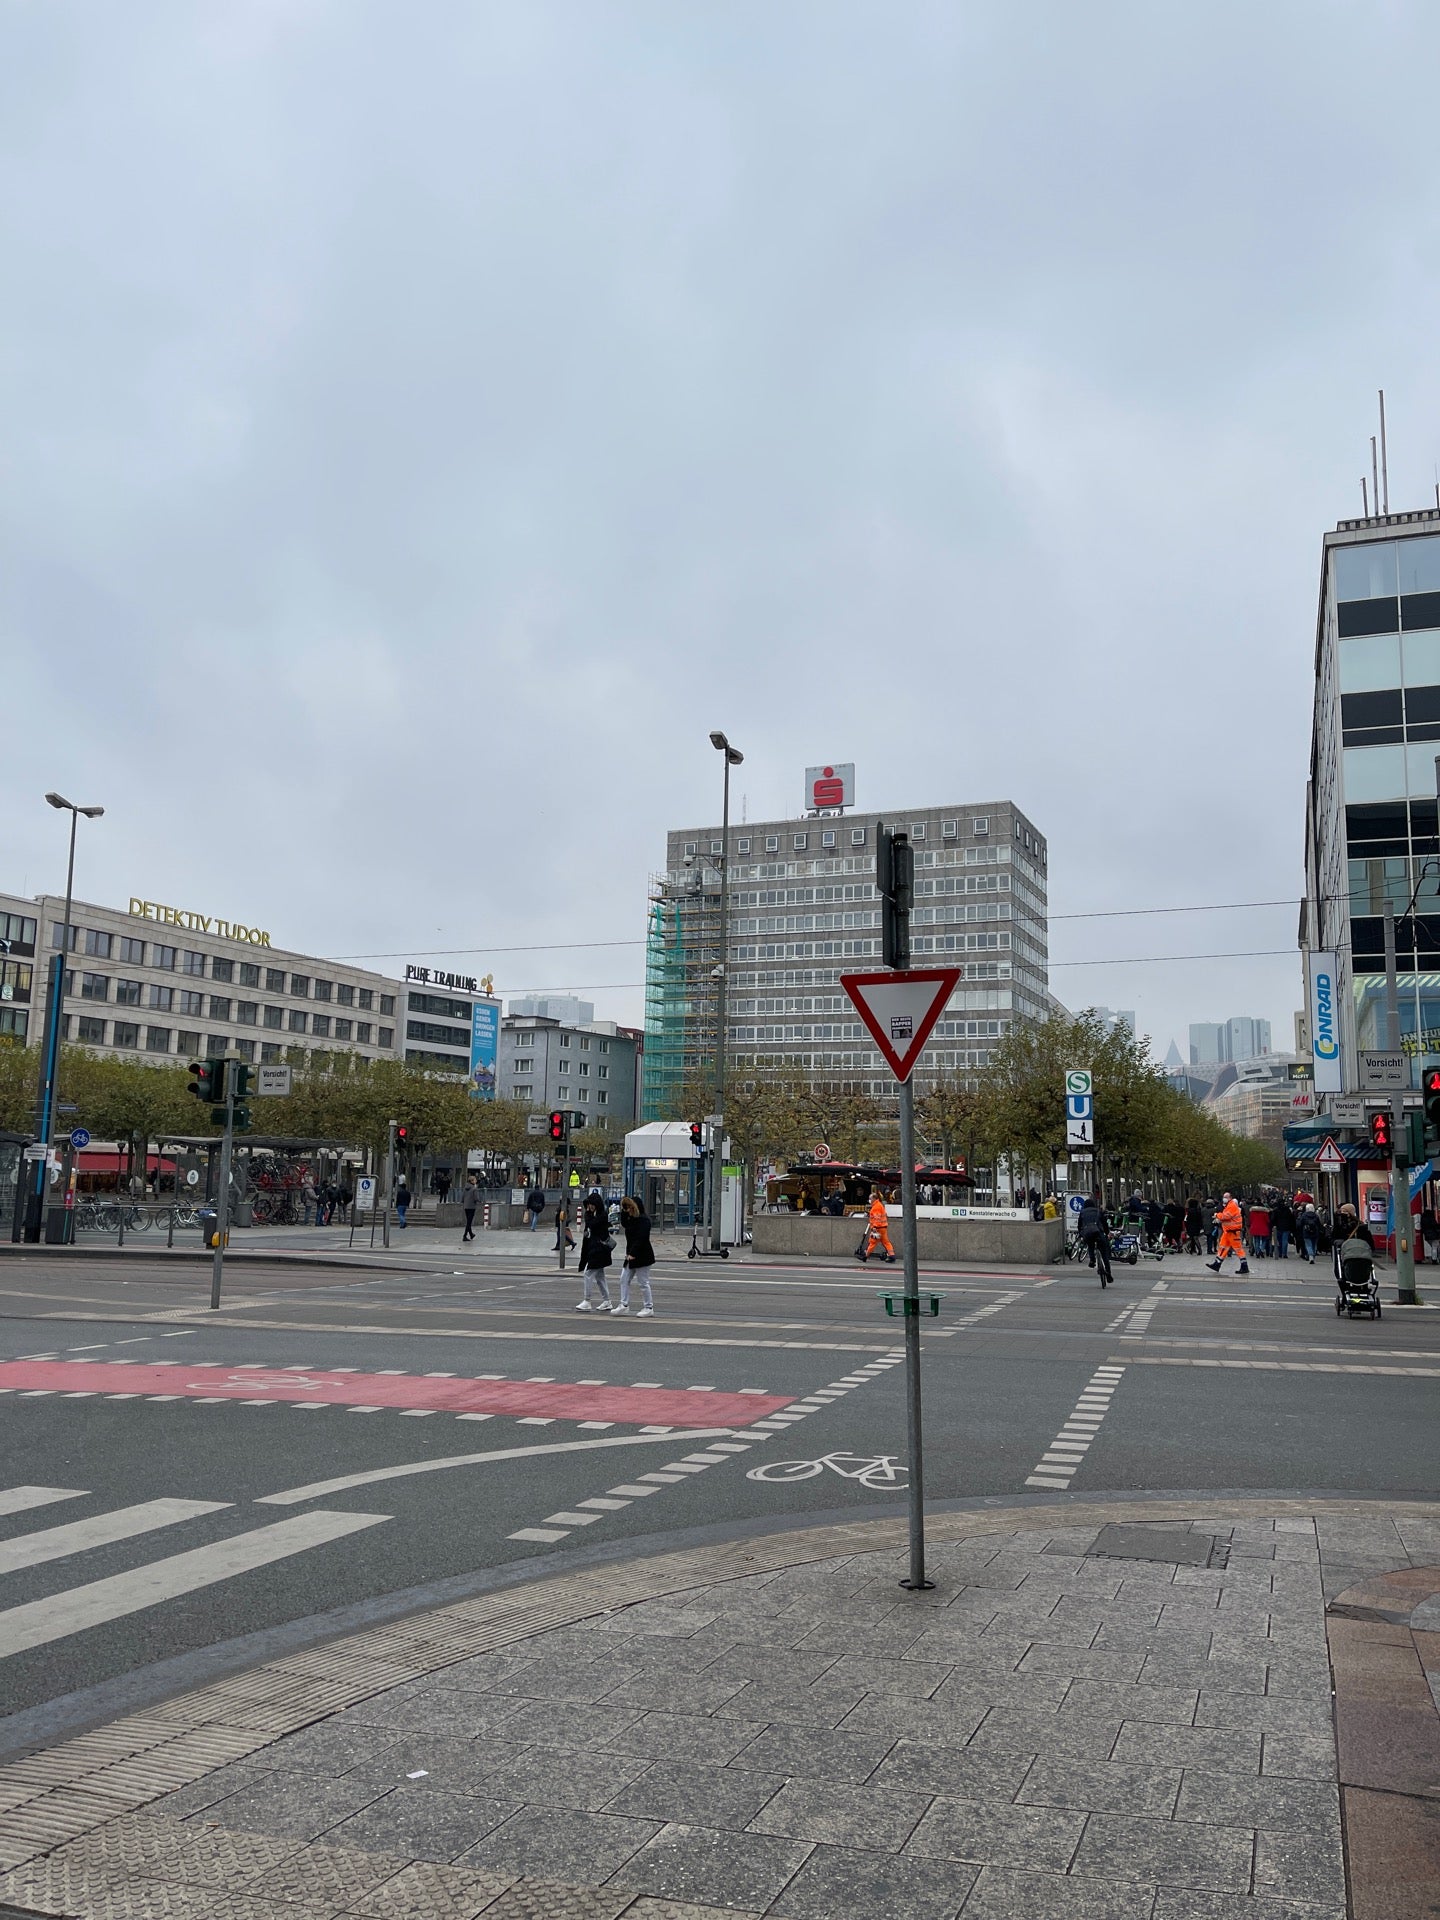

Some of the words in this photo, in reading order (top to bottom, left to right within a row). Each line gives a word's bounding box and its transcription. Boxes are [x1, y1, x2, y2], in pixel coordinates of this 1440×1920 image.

[129, 897, 212, 932] DETEKTIV
[215, 919, 271, 948] TUDOR
[408, 964, 431, 982] PURE
[434, 970, 477, 991] TRAINING
[1314, 973, 1339, 1060] CONRAD
[1366, 1058, 1404, 1067] Vorsicht!
[263, 1070, 287, 1078] Vorsicht!
[1070, 1072, 1088, 1093] S
[1068, 1097, 1090, 1118] U
